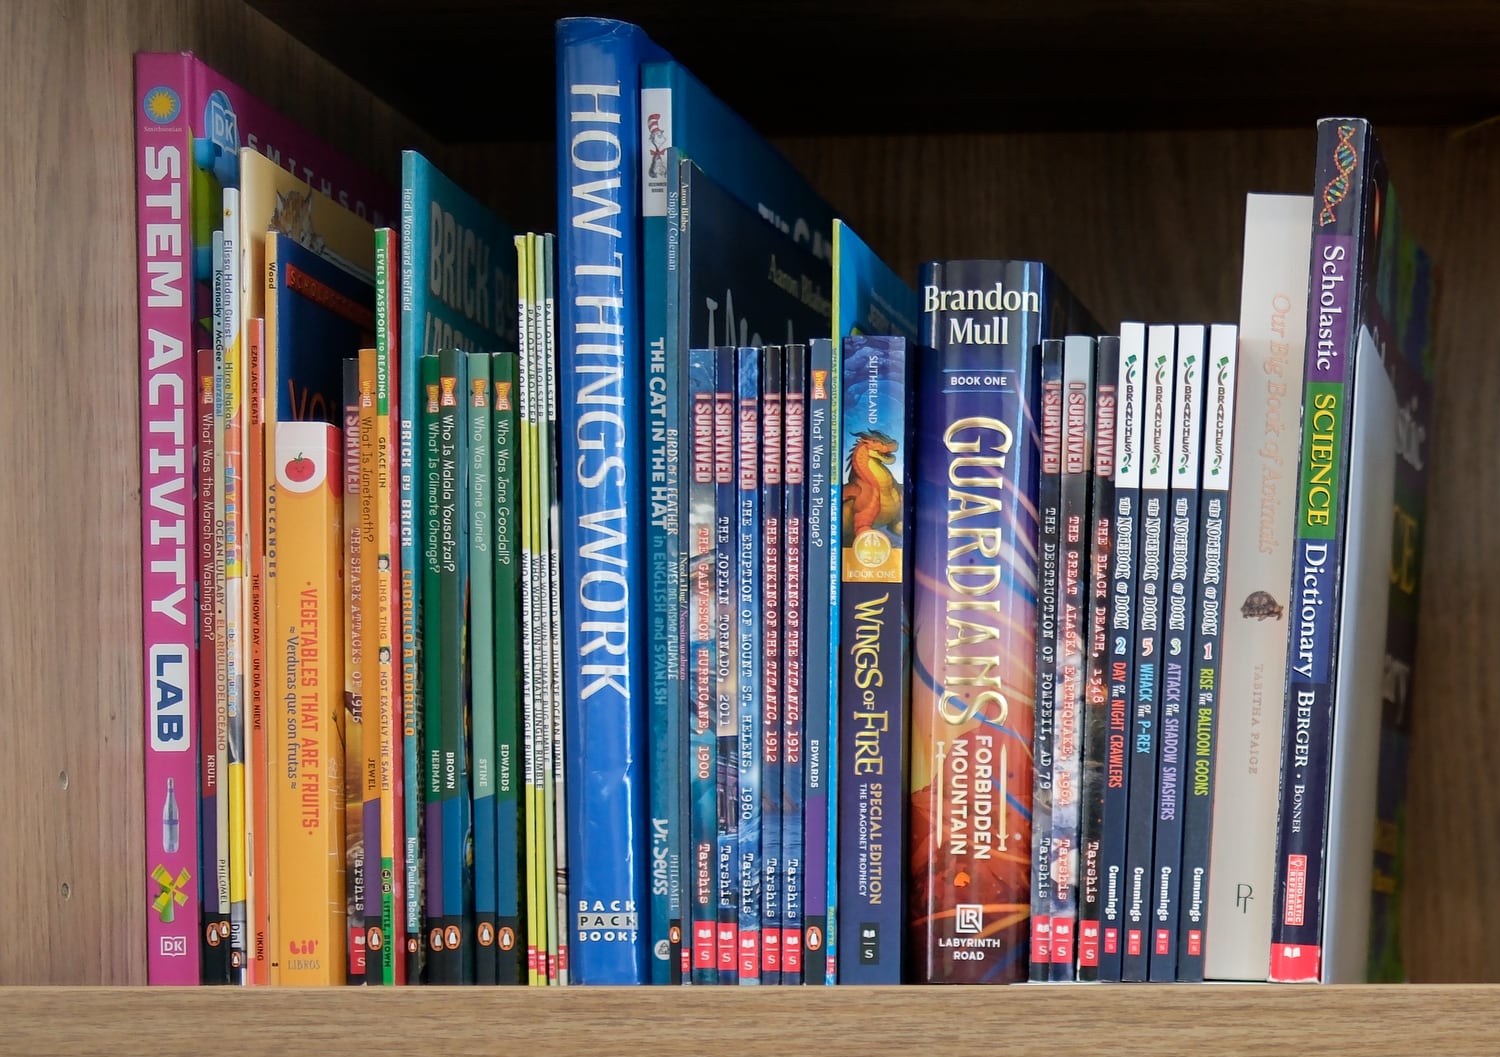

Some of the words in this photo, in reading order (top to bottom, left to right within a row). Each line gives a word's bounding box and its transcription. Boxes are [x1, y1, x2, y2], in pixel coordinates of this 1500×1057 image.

[570, 83, 622, 238] HOW
[403, 188, 412, 212] Heidi
[146, 146, 182, 307] STEM
[403, 215, 413, 265] Woodward
[268, 262, 276, 289] Wood
[377, 249, 385, 275] LEVEL
[403, 269, 413, 311] Sheffield
[924, 282, 1039, 313] Brandon
[1316, 245, 1345, 371] Scholastic
[377, 289, 385, 338] PASSPORT
[949, 317, 1008, 345] Mull
[575, 253, 627, 488] THINGS
[650, 338, 664, 373] THE
[378, 354, 386, 398] READING
[868, 355, 878, 424] SUTHERLAND
[950, 376, 978, 386] BOOK
[980, 376, 1007, 386] ONE
[650, 376, 666, 417] CAT
[202, 413, 212, 445] What
[401, 420, 412, 467] BRICK
[498, 420, 508, 444] Who
[651, 421, 665, 440] IN
[785, 403, 802, 484] SURVIVED
[812, 409, 824, 440] What
[202, 449, 213, 473] Was
[498, 449, 508, 473] Was
[652, 446, 664, 482] THE
[812, 445, 823, 469] Was
[1307, 394, 1336, 527] SCIENCE
[147, 329, 186, 625] ACTIVITY
[203, 477, 214, 496] the
[498, 476, 509, 503] Jane
[812, 473, 823, 493] the
[203, 501, 214, 538] March
[402, 500, 412, 547] BRICK
[651, 487, 667, 529] HAT
[809, 498, 823, 547] Plague?
[1208, 499, 1220, 517] THE
[268, 484, 276, 578] VOLCANOES
[498, 507, 509, 564] Goodall?
[788, 518, 799, 544] THE
[203, 544, 211, 558] on
[1204, 520, 1221, 584] NOTEBOOK
[788, 548, 799, 607] SINKING
[938, 416, 1013, 727] GUARDIANS
[202, 563, 215, 640] Washington?
[577, 508, 632, 699] WORK
[1205, 587, 1217, 599] OF
[1292, 544, 1328, 678] Dictionary
[788, 611, 798, 627] OF
[1202, 601, 1218, 635] DOOM
[300, 590, 318, 686] VEGETABLES
[788, 631, 799, 657] THE
[854, 593, 889, 688] WINGS
[1203, 643, 1213, 660] 1
[286, 637, 298, 689] Verduras
[1200, 668, 1214, 690] RISE
[156, 654, 183, 742] LAB
[284, 693, 296, 714] que
[302, 693, 319, 732] THAT
[786, 660, 800, 726] TITANIC,
[863, 690, 874, 710] OF
[1198, 693, 1207, 705] THE
[1206, 693, 1213, 702] OF
[288, 718, 297, 739] son
[787, 730, 798, 763] 1912
[853, 711, 889, 775] FIRE
[1196, 708, 1212, 756] BALLOON
[1294, 691, 1316, 768] BERGER
[207, 754, 215, 786] KRULL
[288, 743, 300, 779] frutas
[302, 737, 319, 768] ARE
[501, 744, 509, 791] EDWARDS
[810, 740, 819, 788] EDWARDS
[950, 739, 968, 855] MOUNTAIN
[1193, 759, 1210, 796] GOONS
[302, 774, 319, 828] FRUITS
[869, 783, 882, 839] SPECIAL
[973, 735, 992, 860] FORBIDDEN
[1291, 785, 1305, 833] BONNER
[652, 818, 668, 846] Dr.
[652, 849, 669, 895] Seuss
[787, 859, 798, 919] Tarshis
[869, 844, 881, 905] EDITION
[579, 900, 636, 912] BACK
[1189, 867, 1204, 922] Cummings
[1287, 872, 1296, 923] REFERENCE
[1295, 872, 1305, 923] SCHOLASTIC
[579, 916, 636, 927] PACK
[579, 930, 637, 942] BOOKS
[256, 931, 264, 961] VIKING
[939, 939, 1000, 948] LABYRINTH
[953, 952, 984, 960] ROAD
[288, 960, 320, 970] LIBROS
